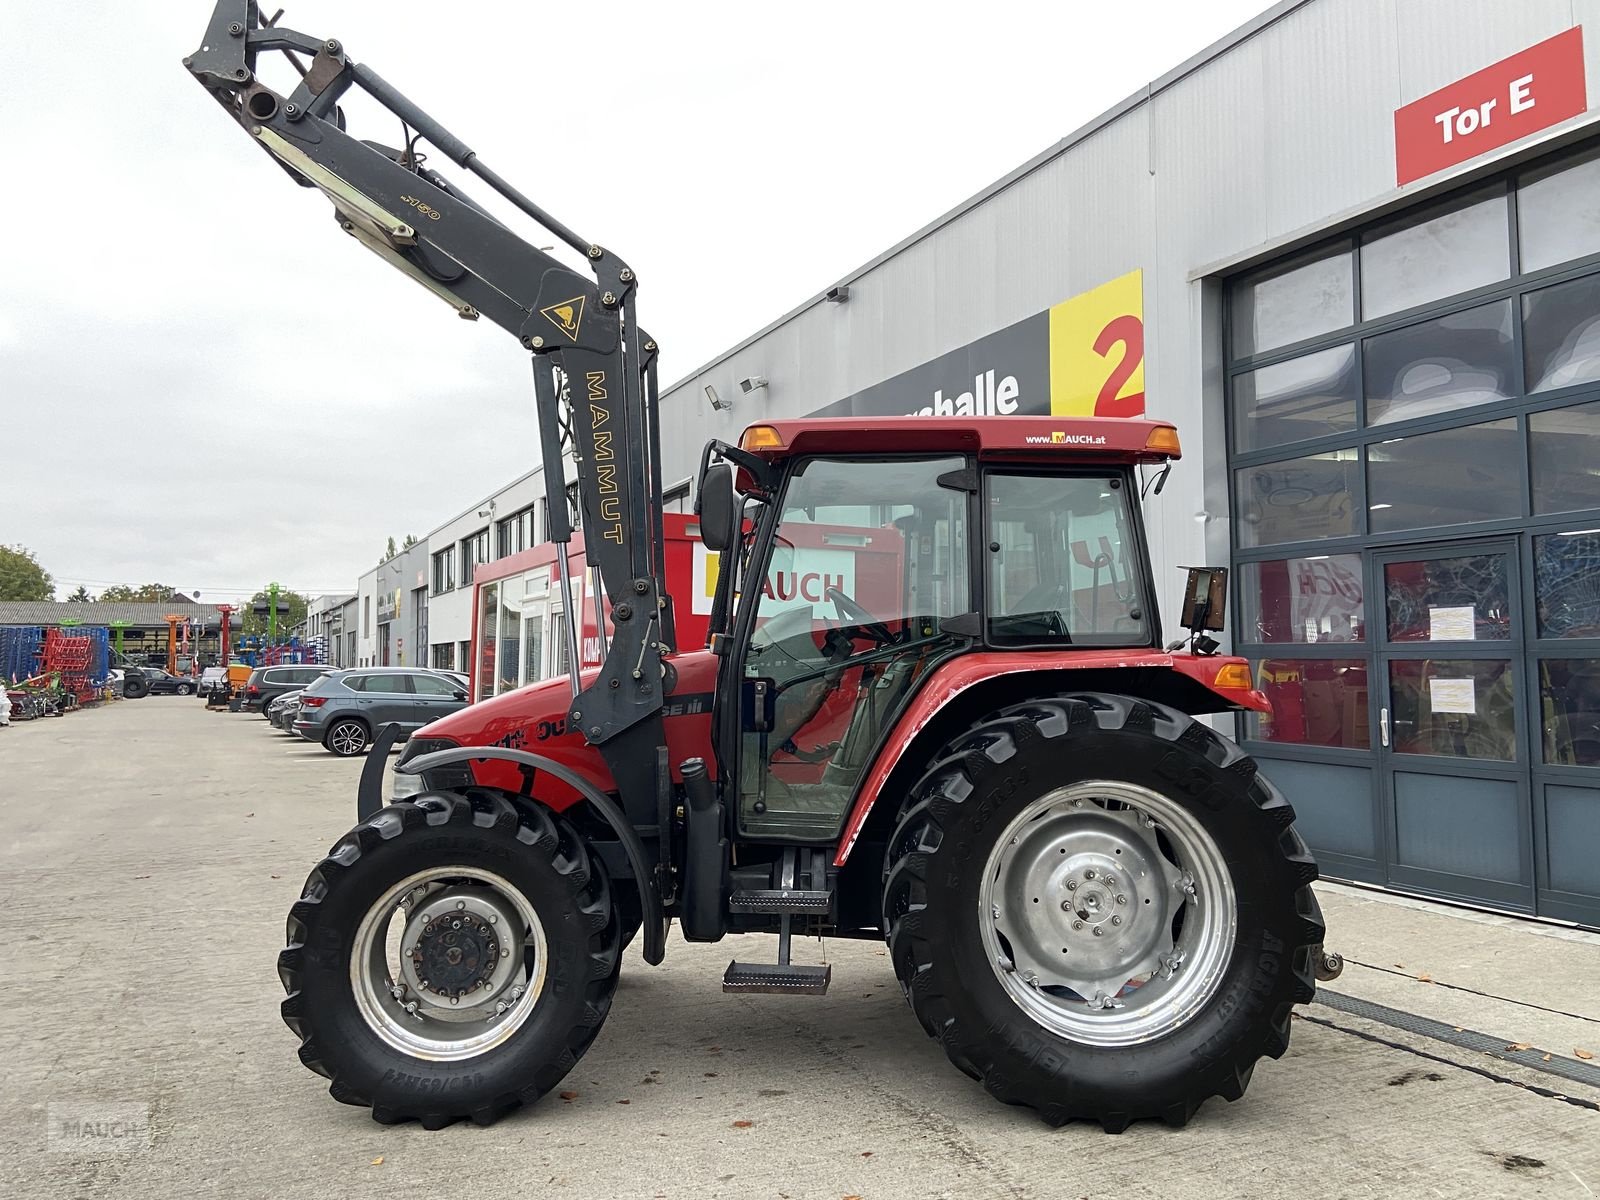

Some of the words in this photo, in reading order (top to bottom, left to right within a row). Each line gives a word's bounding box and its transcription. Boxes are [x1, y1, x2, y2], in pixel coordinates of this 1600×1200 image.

[1434, 98, 1497, 144] Tor
[1509, 73, 1536, 116] E
[903, 369, 1020, 417] halle
[1092, 314, 1145, 418] 2
[586, 370, 624, 545] MAMMUT
[1025, 434, 1107, 445] www.MAUCH.at
[762, 571, 844, 603] AUCH
[661, 703, 683, 717] SE
